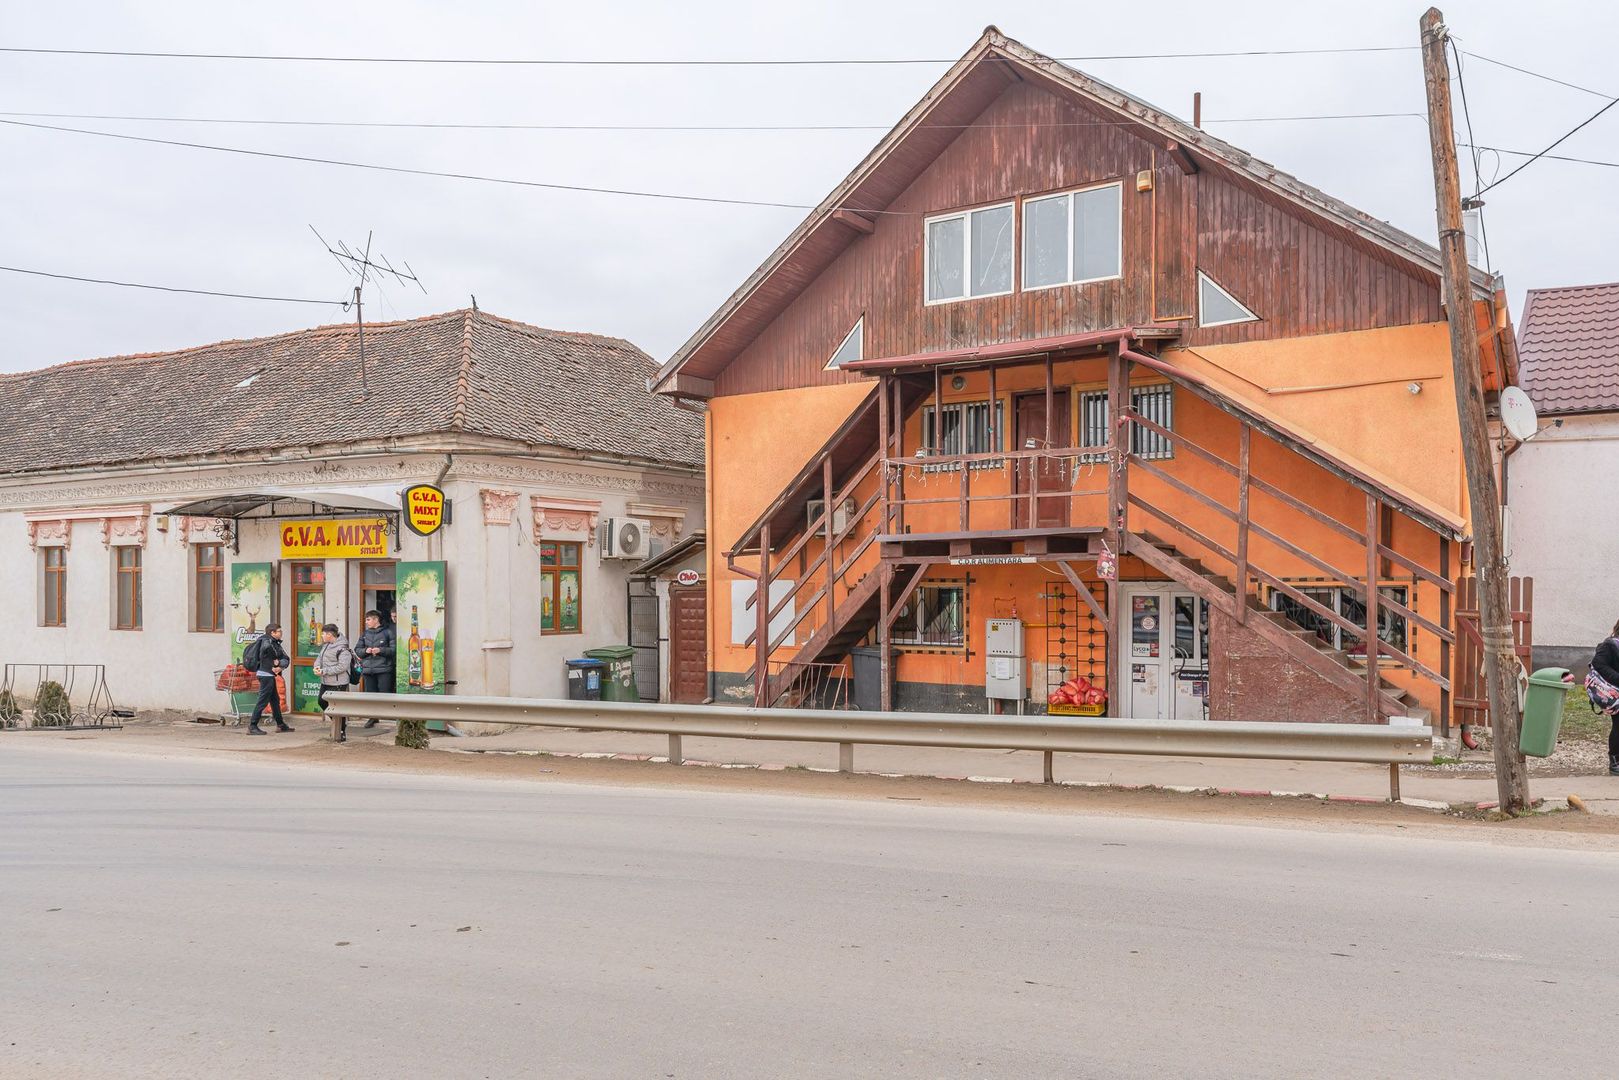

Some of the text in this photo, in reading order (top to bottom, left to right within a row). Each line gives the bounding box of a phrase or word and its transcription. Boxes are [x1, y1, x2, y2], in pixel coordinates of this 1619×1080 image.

[412, 492, 440, 503] G.V.A.
[413, 505, 440, 516] MIXT
[282, 524, 384, 547] G.V.A. MIXT
[360, 546, 383, 555] smart
[977, 556, 1023, 565] ALIMENTARA
[679, 572, 698, 581] Chio
